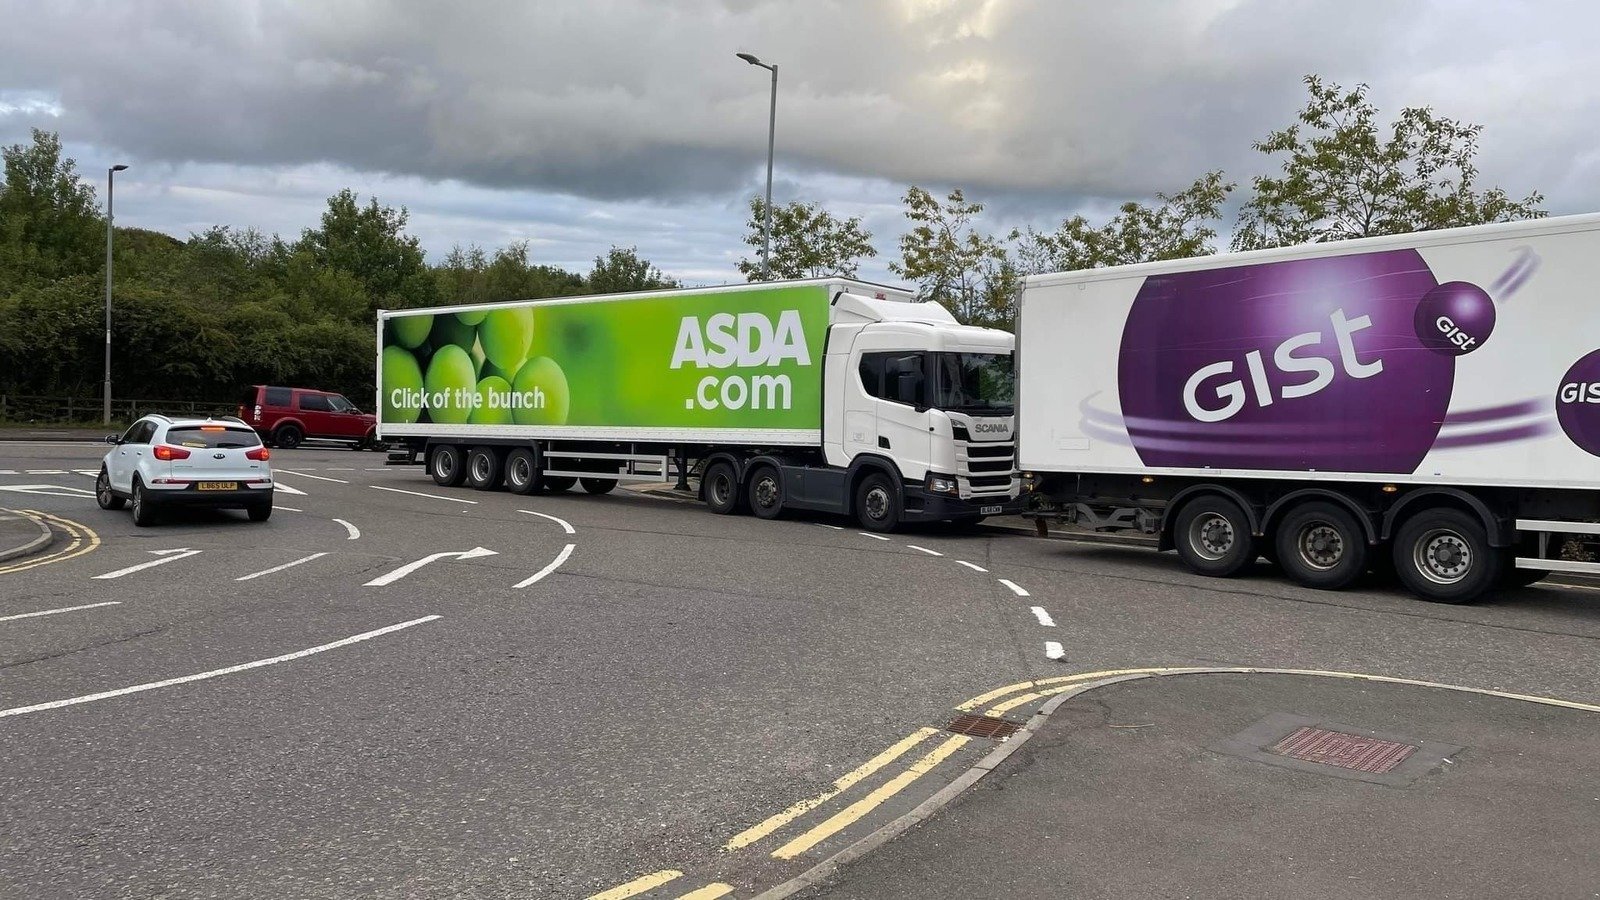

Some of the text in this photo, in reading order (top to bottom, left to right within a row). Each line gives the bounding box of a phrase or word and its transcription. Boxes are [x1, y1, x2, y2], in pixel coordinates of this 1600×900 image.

[670, 309, 812, 369] ASDA
[391, 386, 545, 409] Click of the bunch
[685, 374, 792, 410] .com
[975, 423, 1009, 433] SCANIA
